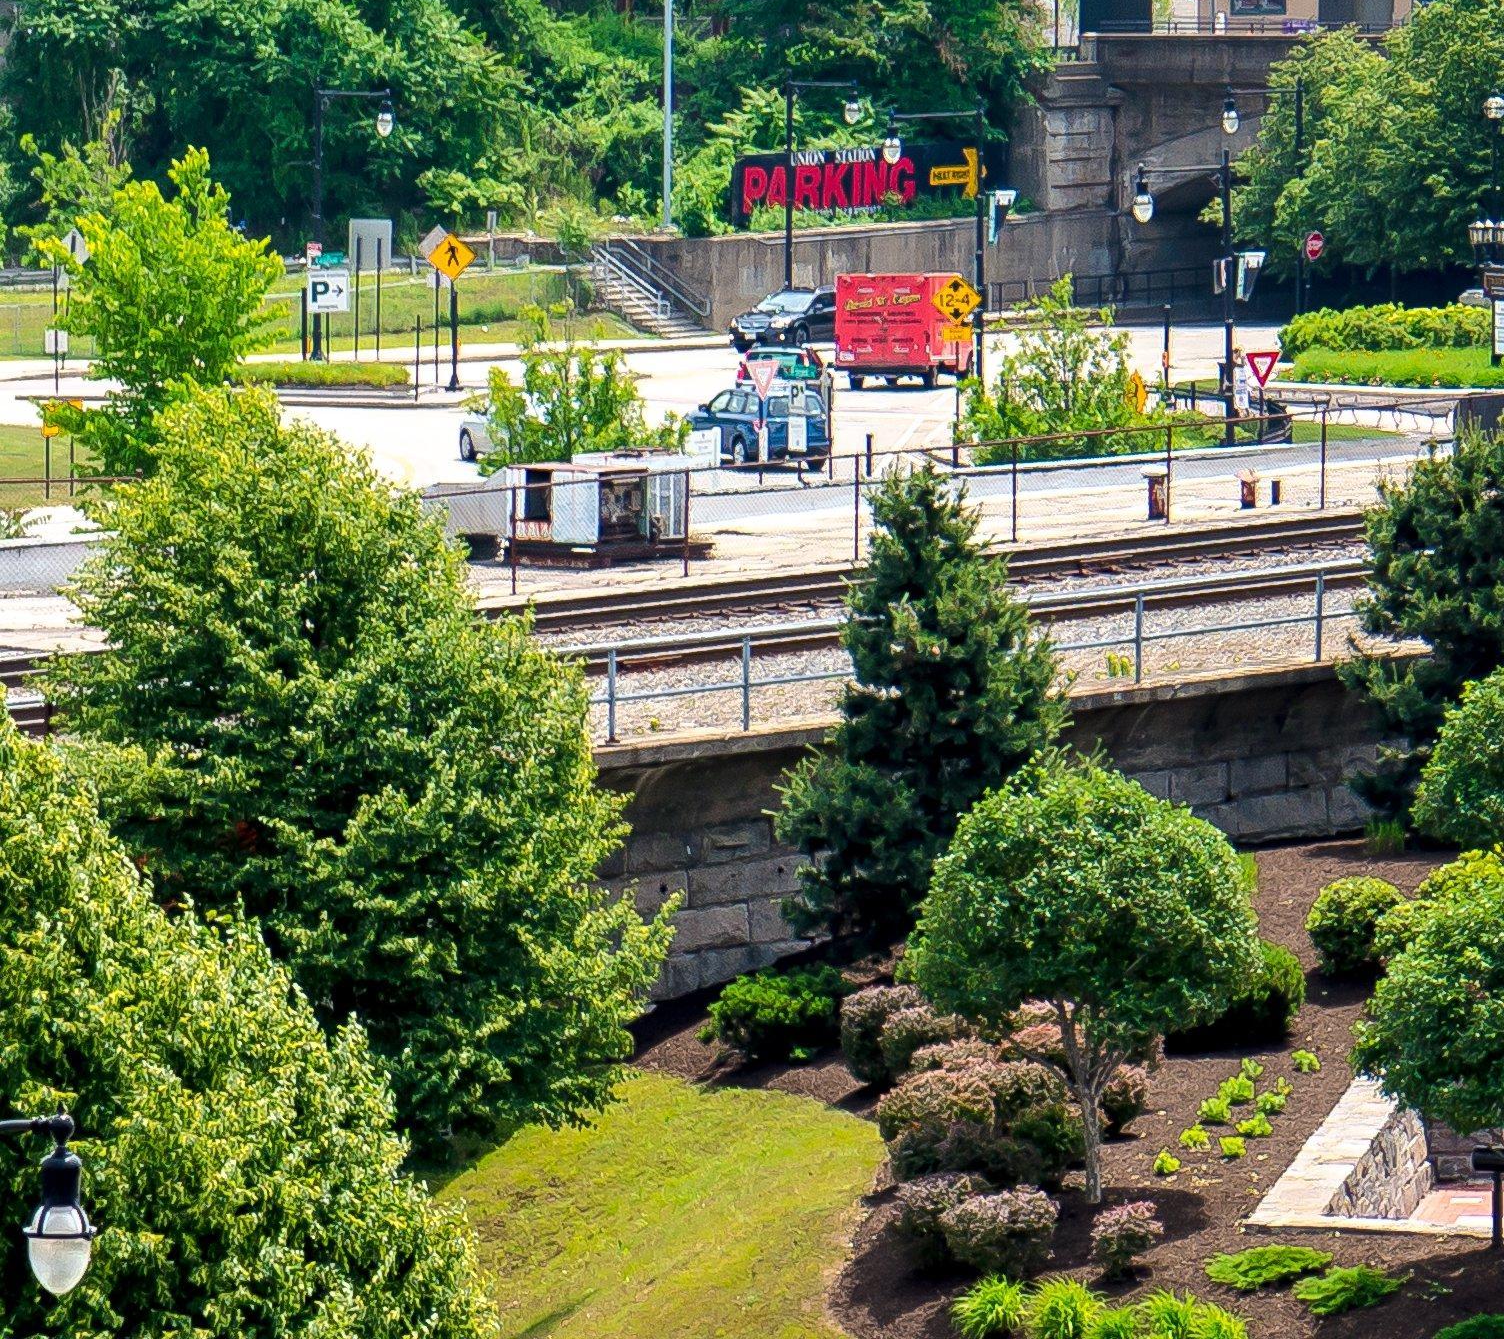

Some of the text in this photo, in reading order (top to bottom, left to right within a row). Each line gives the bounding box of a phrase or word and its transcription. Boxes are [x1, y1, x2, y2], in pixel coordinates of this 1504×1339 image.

[791, 148, 876, 166] UNION STATION
[743, 158, 916, 214] PARKING
[311, 281, 329, 303] P
